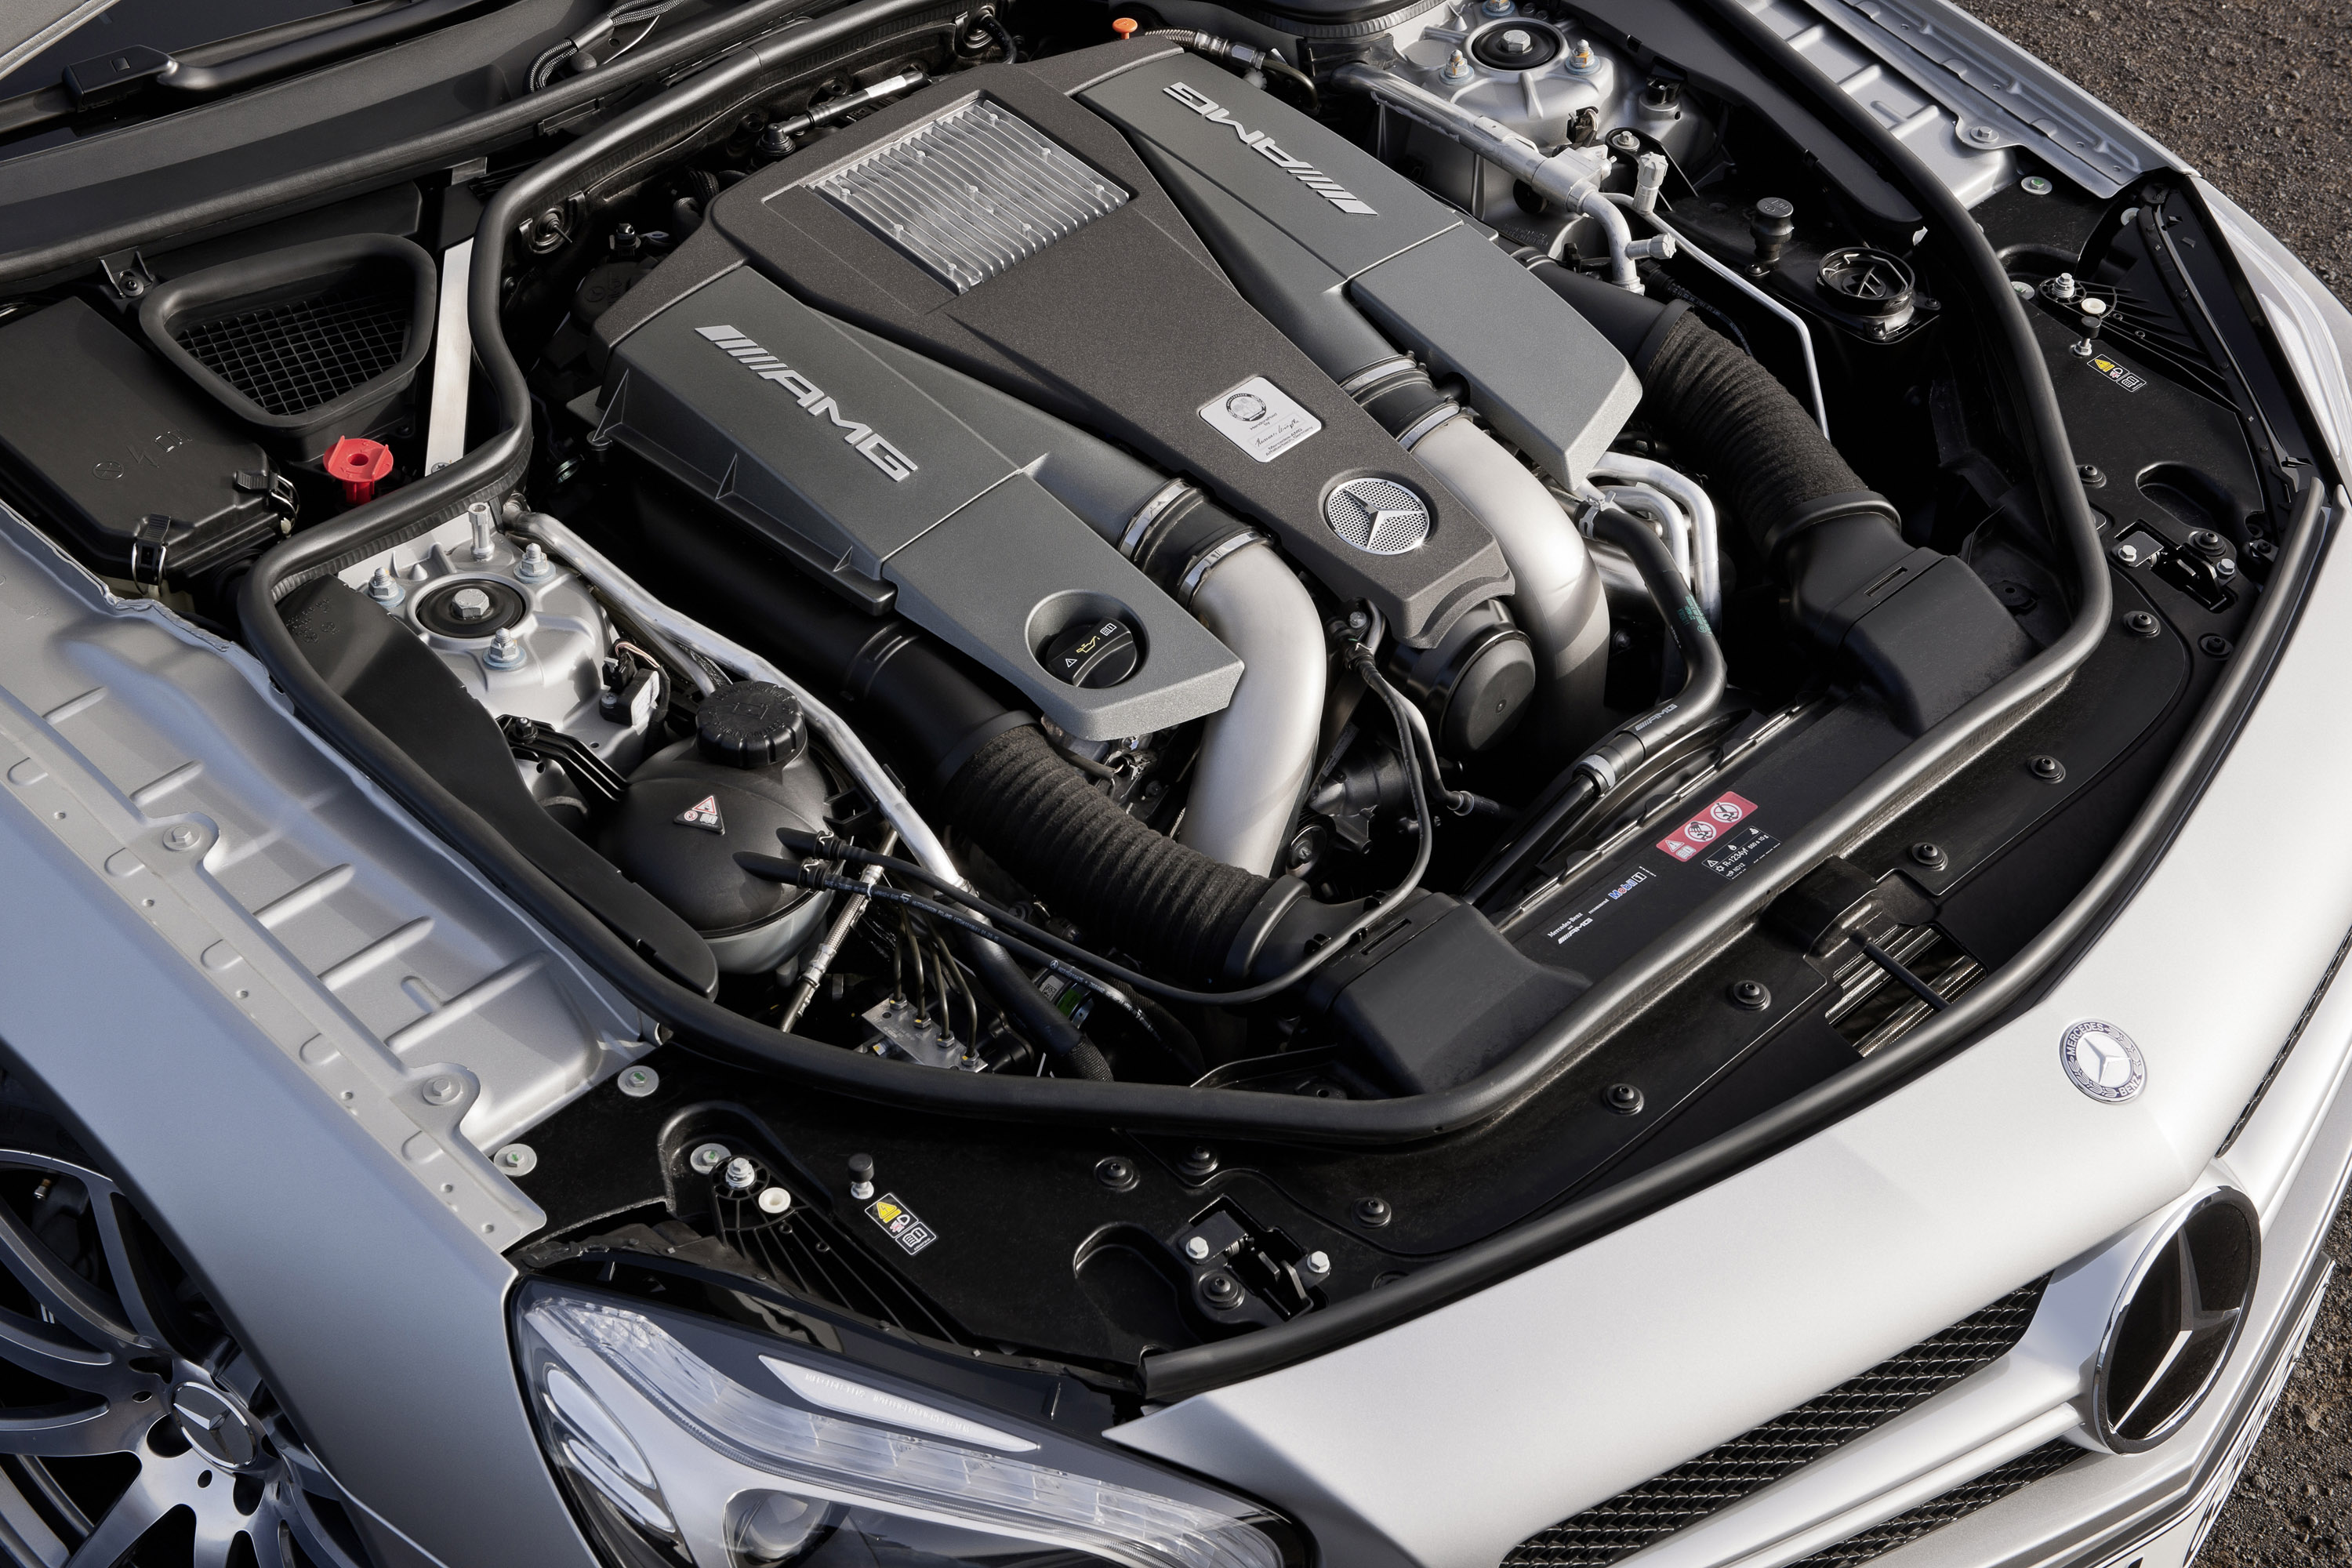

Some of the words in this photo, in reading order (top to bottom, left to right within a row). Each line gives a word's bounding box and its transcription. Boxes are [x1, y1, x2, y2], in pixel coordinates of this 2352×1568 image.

[1163, 82, 1315, 170] AMG
[757, 369, 918, 482] AMG
[1722, 847, 1749, 867] R-1234yf
[1608, 878, 1639, 900] Mobil
[1547, 912, 1583, 938] Mercedes-Benz
[2066, 1022, 2104, 1056] MERCEDES
[2118, 1075, 2141, 1097] BENZ
